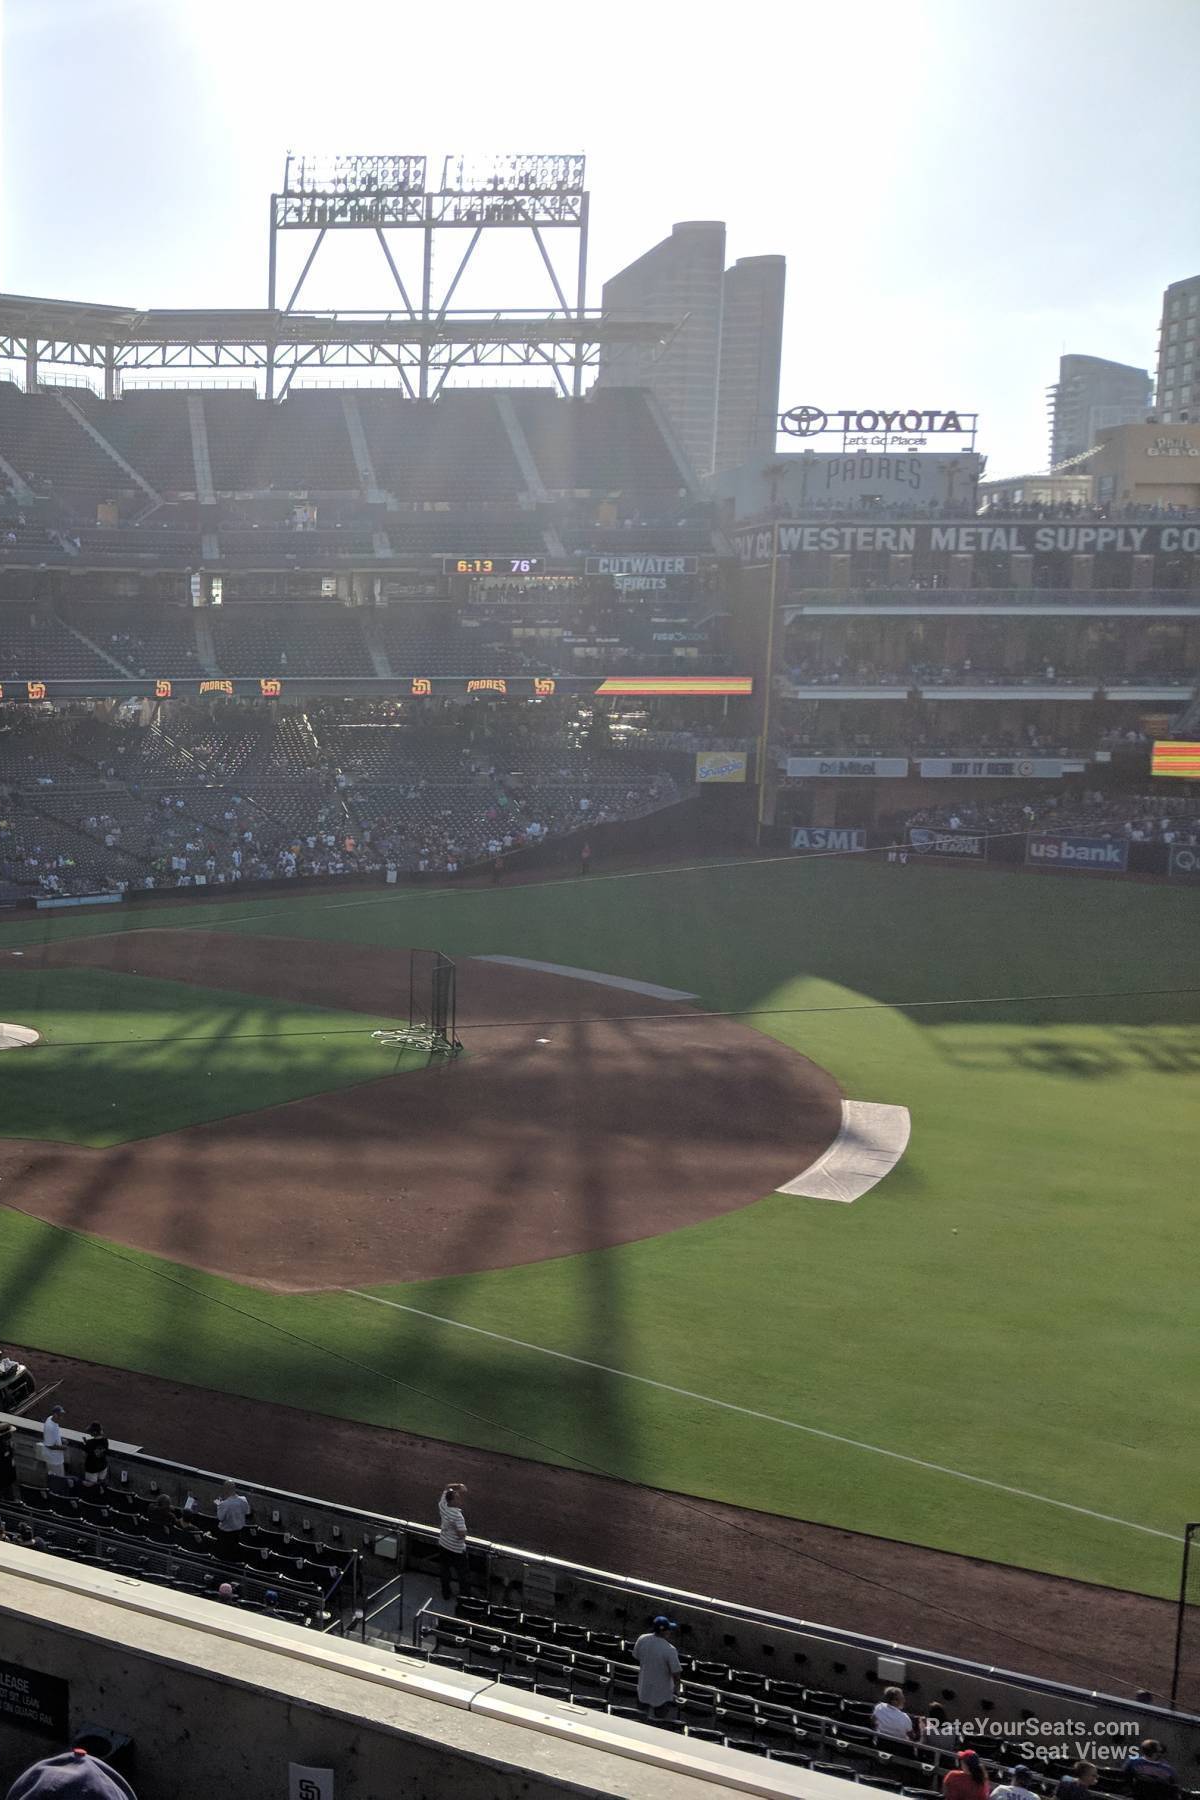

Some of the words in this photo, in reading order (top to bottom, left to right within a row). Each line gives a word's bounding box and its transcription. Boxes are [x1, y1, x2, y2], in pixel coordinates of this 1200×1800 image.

[838, 410, 963, 433] TOYOTA
[843, 436, 869, 445] Let's
[871, 436, 887, 445] Go
[890, 436, 927, 446] Places
[826, 458, 922, 489] PADRES
[779, 527, 916, 552] WESTERN
[930, 527, 1026, 553] METAL
[1034, 527, 1150, 553] SUPPLY
[457, 560, 493, 573] 6:13
[599, 558, 685, 574] CUTWATER
[614, 576, 667, 591] SPIRITS
[199, 680, 233, 695] PADRES
[466, 679, 507, 694] PADRES
[699, 760, 743, 779] Snapple
[839, 762, 876, 776] Mitel
[792, 829, 866, 851] ASML
[3, 1701, 14, 1713] ON
[15, 1705, 38, 1721] GUARD
